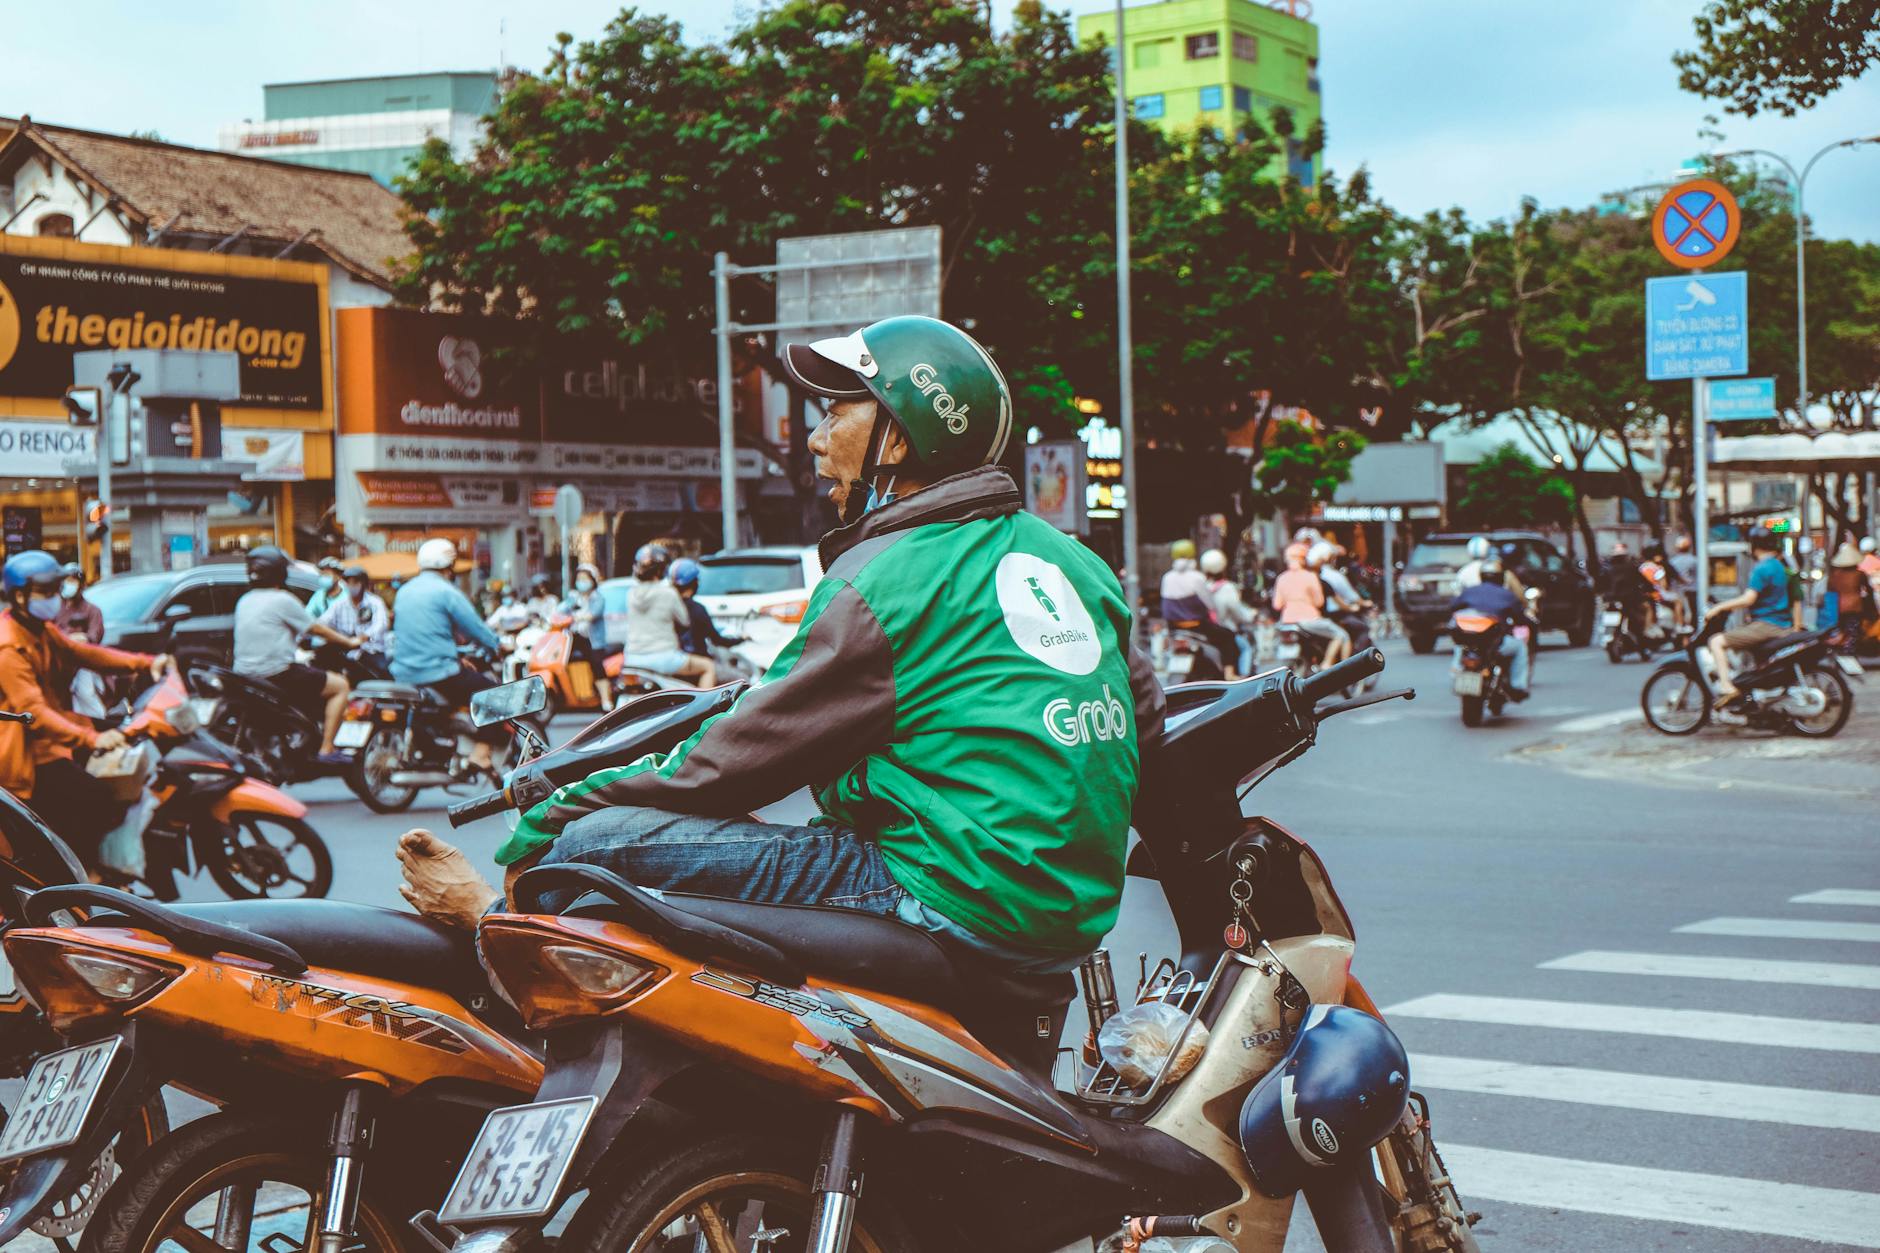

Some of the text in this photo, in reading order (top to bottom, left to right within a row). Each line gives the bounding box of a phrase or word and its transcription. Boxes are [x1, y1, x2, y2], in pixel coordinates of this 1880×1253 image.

[35, 306, 306, 369] thegioididong
[910, 362, 969, 435] Grab
[20, 430, 86, 454] RENO4
[1039, 629, 1089, 648] GrabBike
[1042, 685, 1127, 747] Grab
[6, 1095, 80, 1152] 2890
[459, 1159, 553, 1213] 9553
